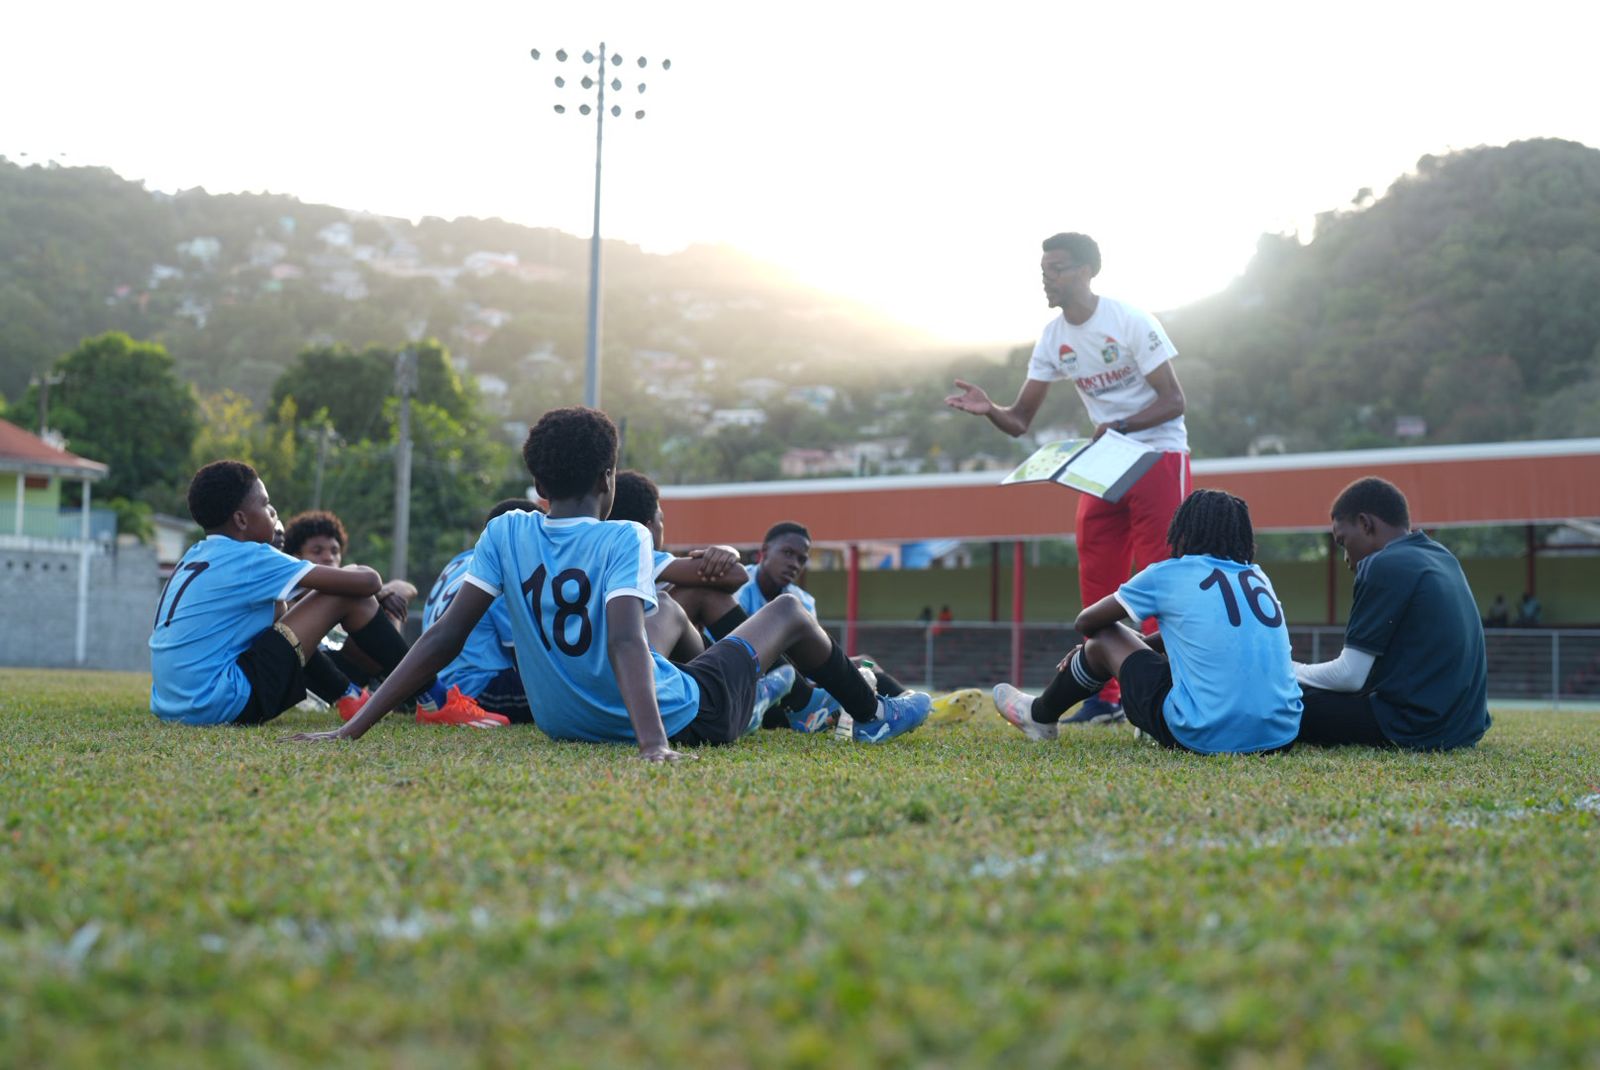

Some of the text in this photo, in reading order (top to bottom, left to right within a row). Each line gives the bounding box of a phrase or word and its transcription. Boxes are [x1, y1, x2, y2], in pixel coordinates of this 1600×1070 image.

[154, 560, 210, 630] 17
[522, 563, 592, 657] 18
[1199, 567, 1283, 628] 16
